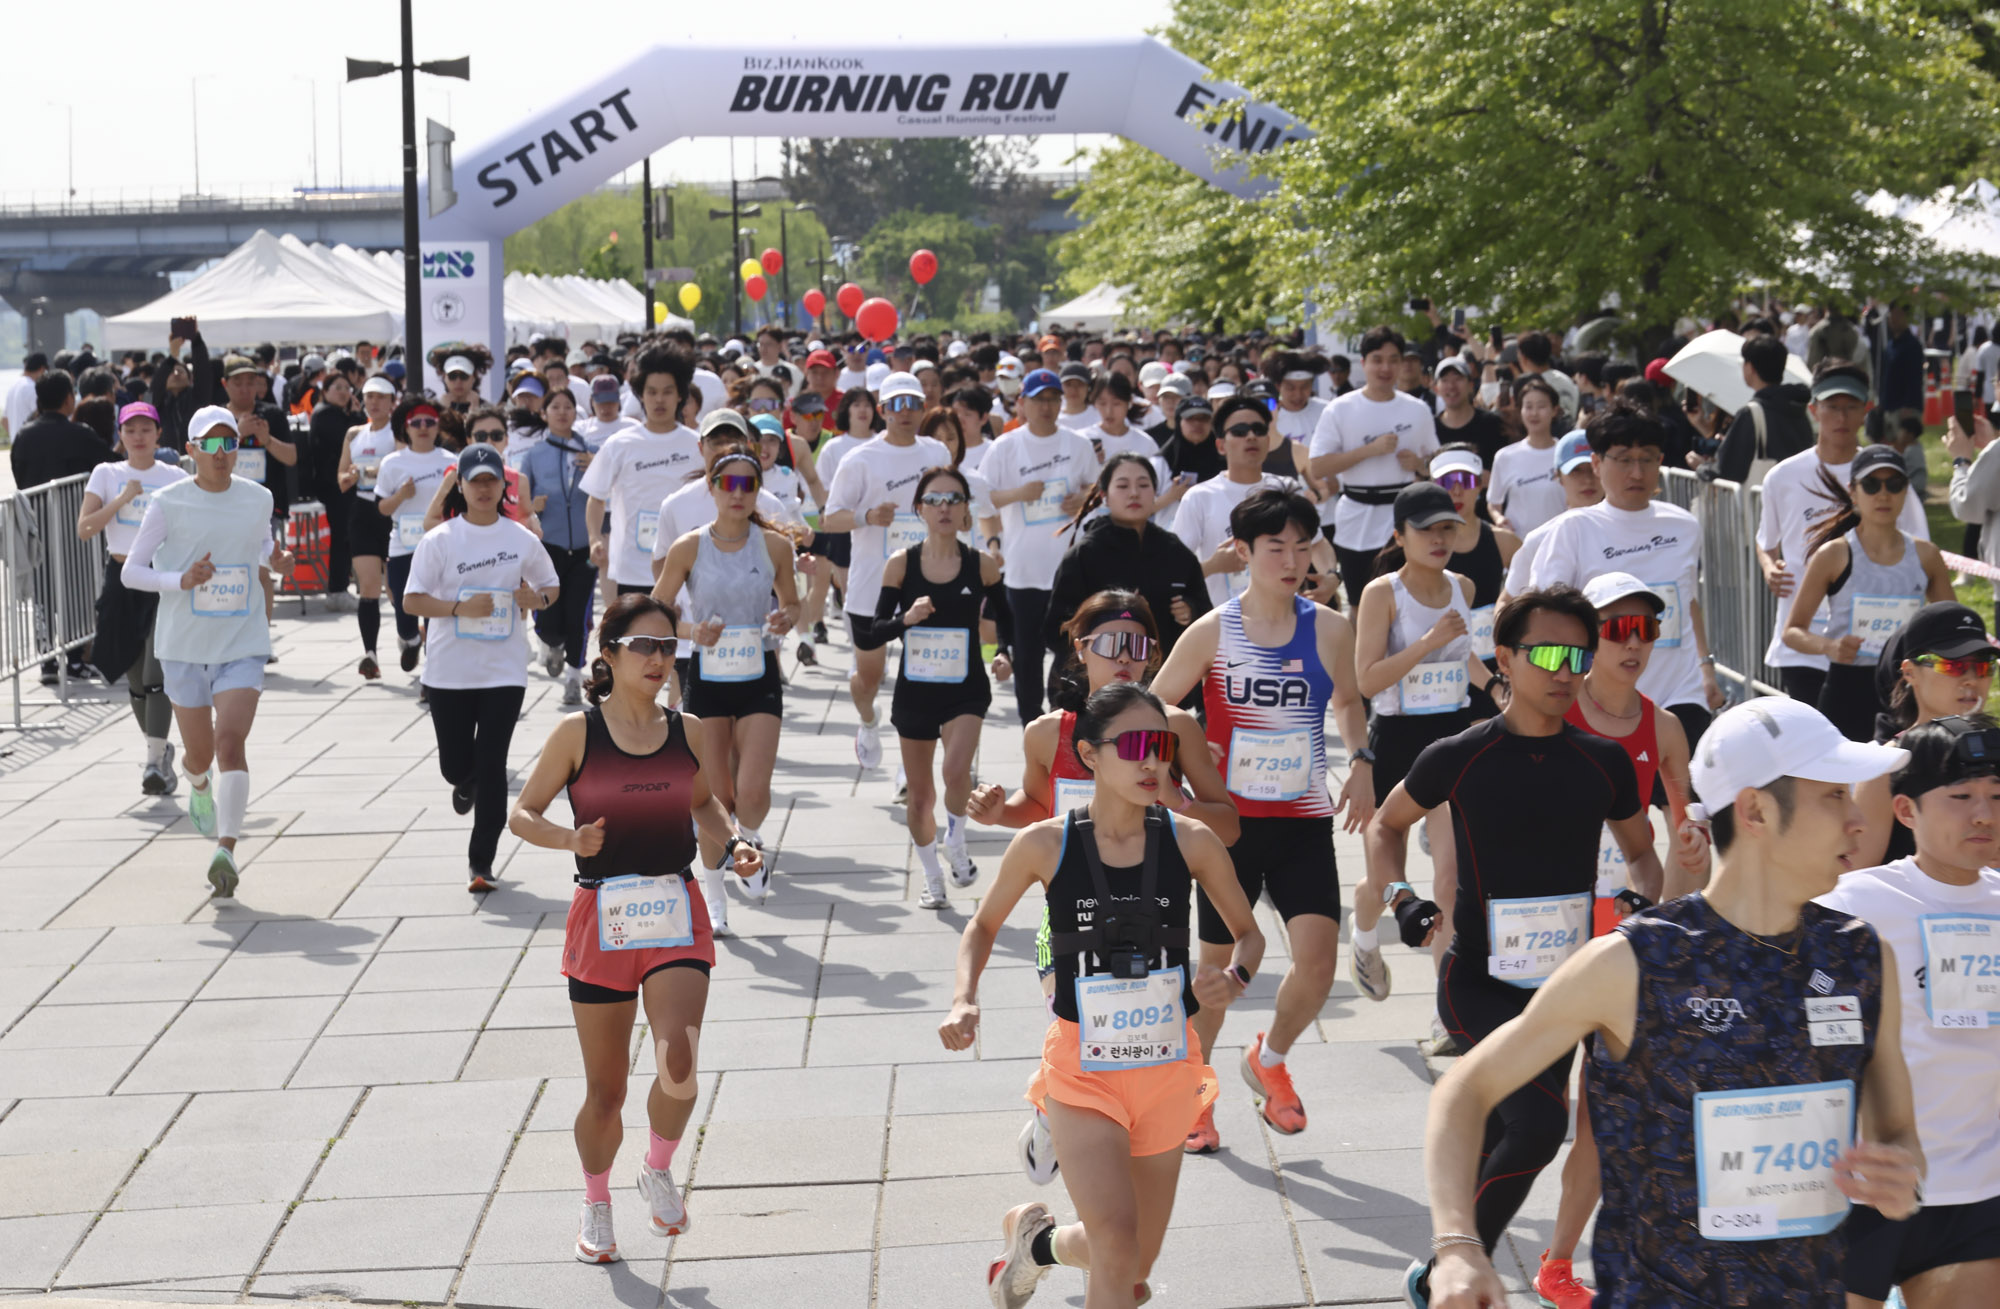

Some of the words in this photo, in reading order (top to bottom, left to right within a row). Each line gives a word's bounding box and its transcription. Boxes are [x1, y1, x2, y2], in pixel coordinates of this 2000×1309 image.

[729, 74, 952, 113] BURNING
[959, 71, 1069, 111] RUN
[897, 114, 942, 125] Casual
[946, 114, 1001, 125] Running
[1005, 113, 1056, 124] Festival
[477, 88, 638, 208] START
[635, 458, 669, 472] Burning
[670, 453, 690, 462] Run
[1019, 461, 1052, 476] Burning
[1603, 543, 1651, 560] Burning
[1650, 535, 1678, 546] Run
[457, 557, 497, 574] Burning
[497, 551, 518, 561] Run
[200, 585, 208, 593] M
[211, 584, 245, 595] 7040
[1474, 625, 1492, 637] 40
[1858, 619, 1869, 628] W
[1871, 618, 1902, 631] 821
[707, 648, 716, 656] W
[718, 646, 756, 658] 8149
[912, 648, 920, 657] W
[922, 648, 960, 660] 8132
[1408, 674, 1419, 684] W
[1422, 668, 1463, 685] 8146
[1226, 675, 1310, 707] USA
[1239, 758, 1252, 767] M
[1255, 756, 1303, 771] 7394
[622, 782, 671, 792] SPYDER
[609, 906, 622, 916] W
[625, 898, 678, 917] 8097
[1505, 936, 1519, 948] M
[1525, 927, 1578, 950] 7284
[1499, 960, 1527, 970] E-47
[1941, 958, 1956, 973] M
[1086, 983, 1127, 994] BURNING
[1129, 980, 1148, 989] RUN
[1093, 1014, 1108, 1028] W
[1112, 1004, 1174, 1030] 8092
[1110, 1044, 1154, 1059] 런치광이
[1713, 1102, 1774, 1118] BURNING
[1776, 1099, 1806, 1112] RUN
[1720, 1151, 1744, 1171] M
[1752, 1138, 1840, 1174] 7408
[1711, 1213, 1762, 1229] C-304
